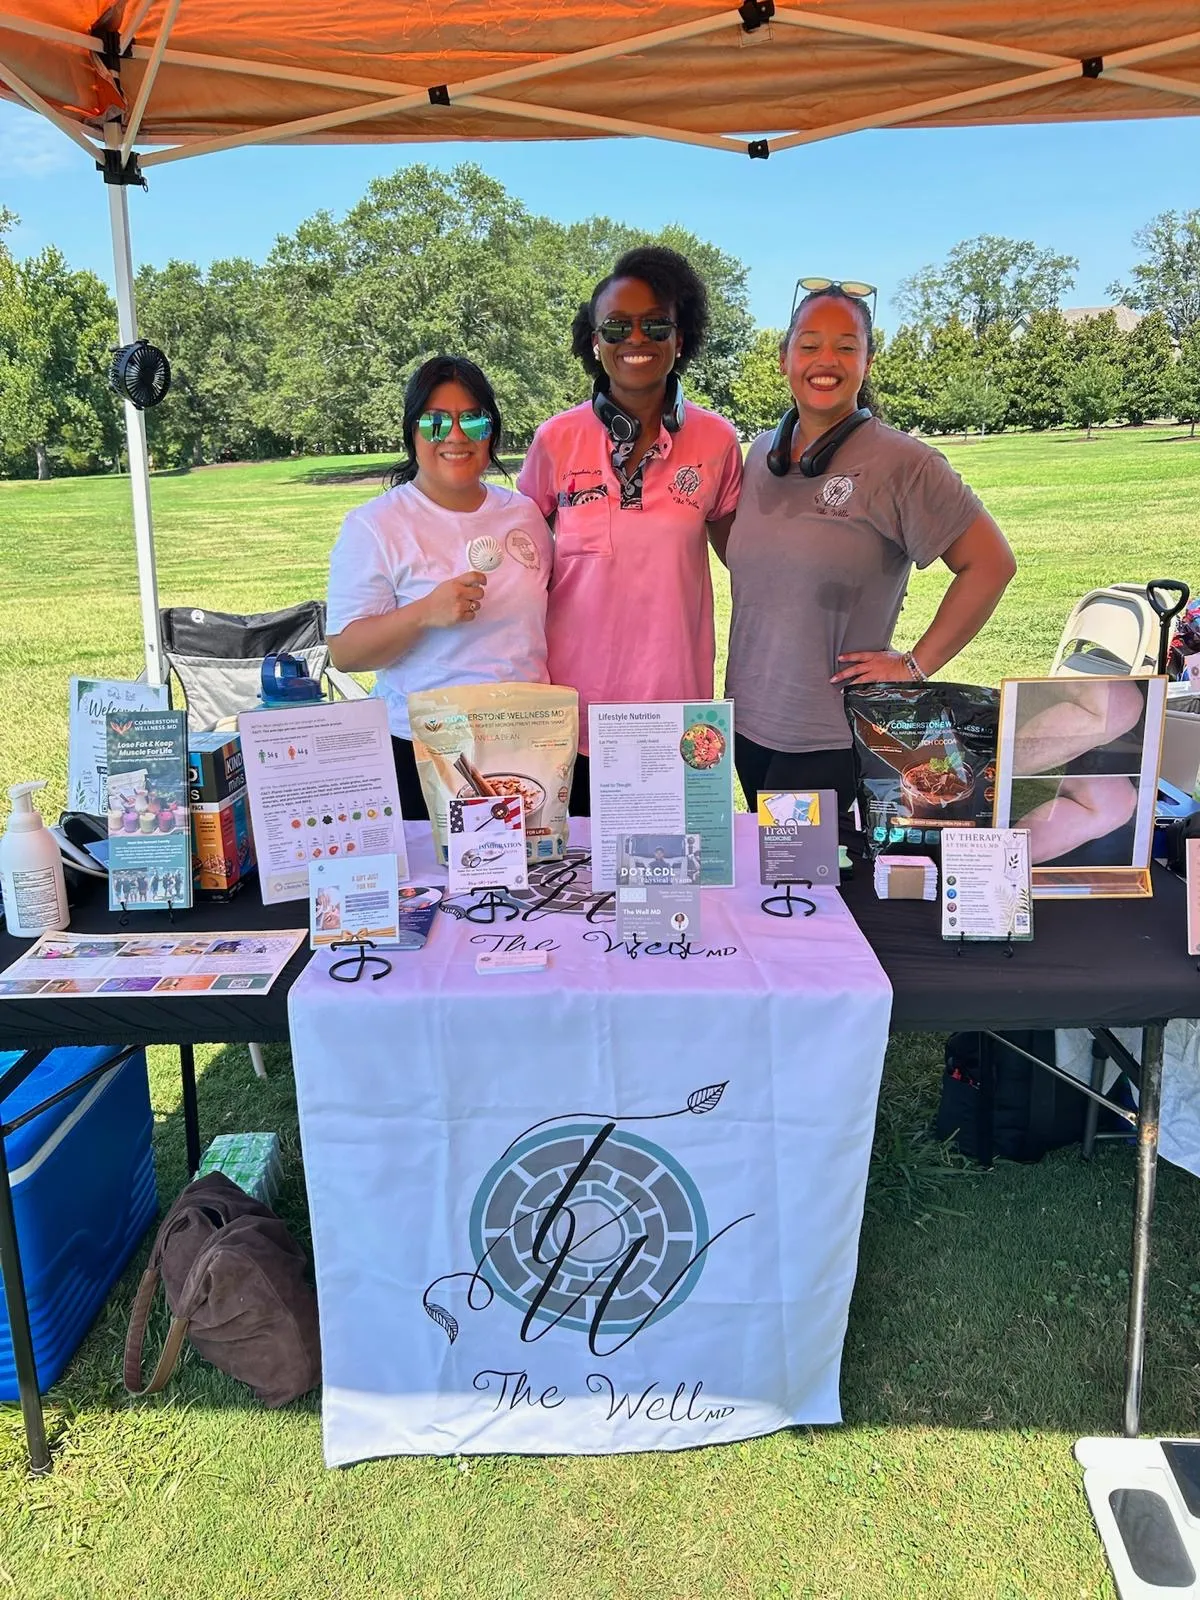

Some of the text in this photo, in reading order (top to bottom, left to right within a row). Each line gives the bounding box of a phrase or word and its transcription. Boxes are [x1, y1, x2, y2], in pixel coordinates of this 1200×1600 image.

[507, 710, 550, 720] WELLNESS
[551, 710, 564, 718] MD
[598, 713, 628, 721] Lifestyle
[227, 753, 242, 773] KIND
[764, 825, 798, 835] Travel
[945, 833, 1001, 841] IV THERAPY
[621, 867, 675, 877] DOT&CDL
[475, 930, 561, 952] The
[706, 946, 738, 958] MD
[473, 1369, 735, 1423] The Well MD
